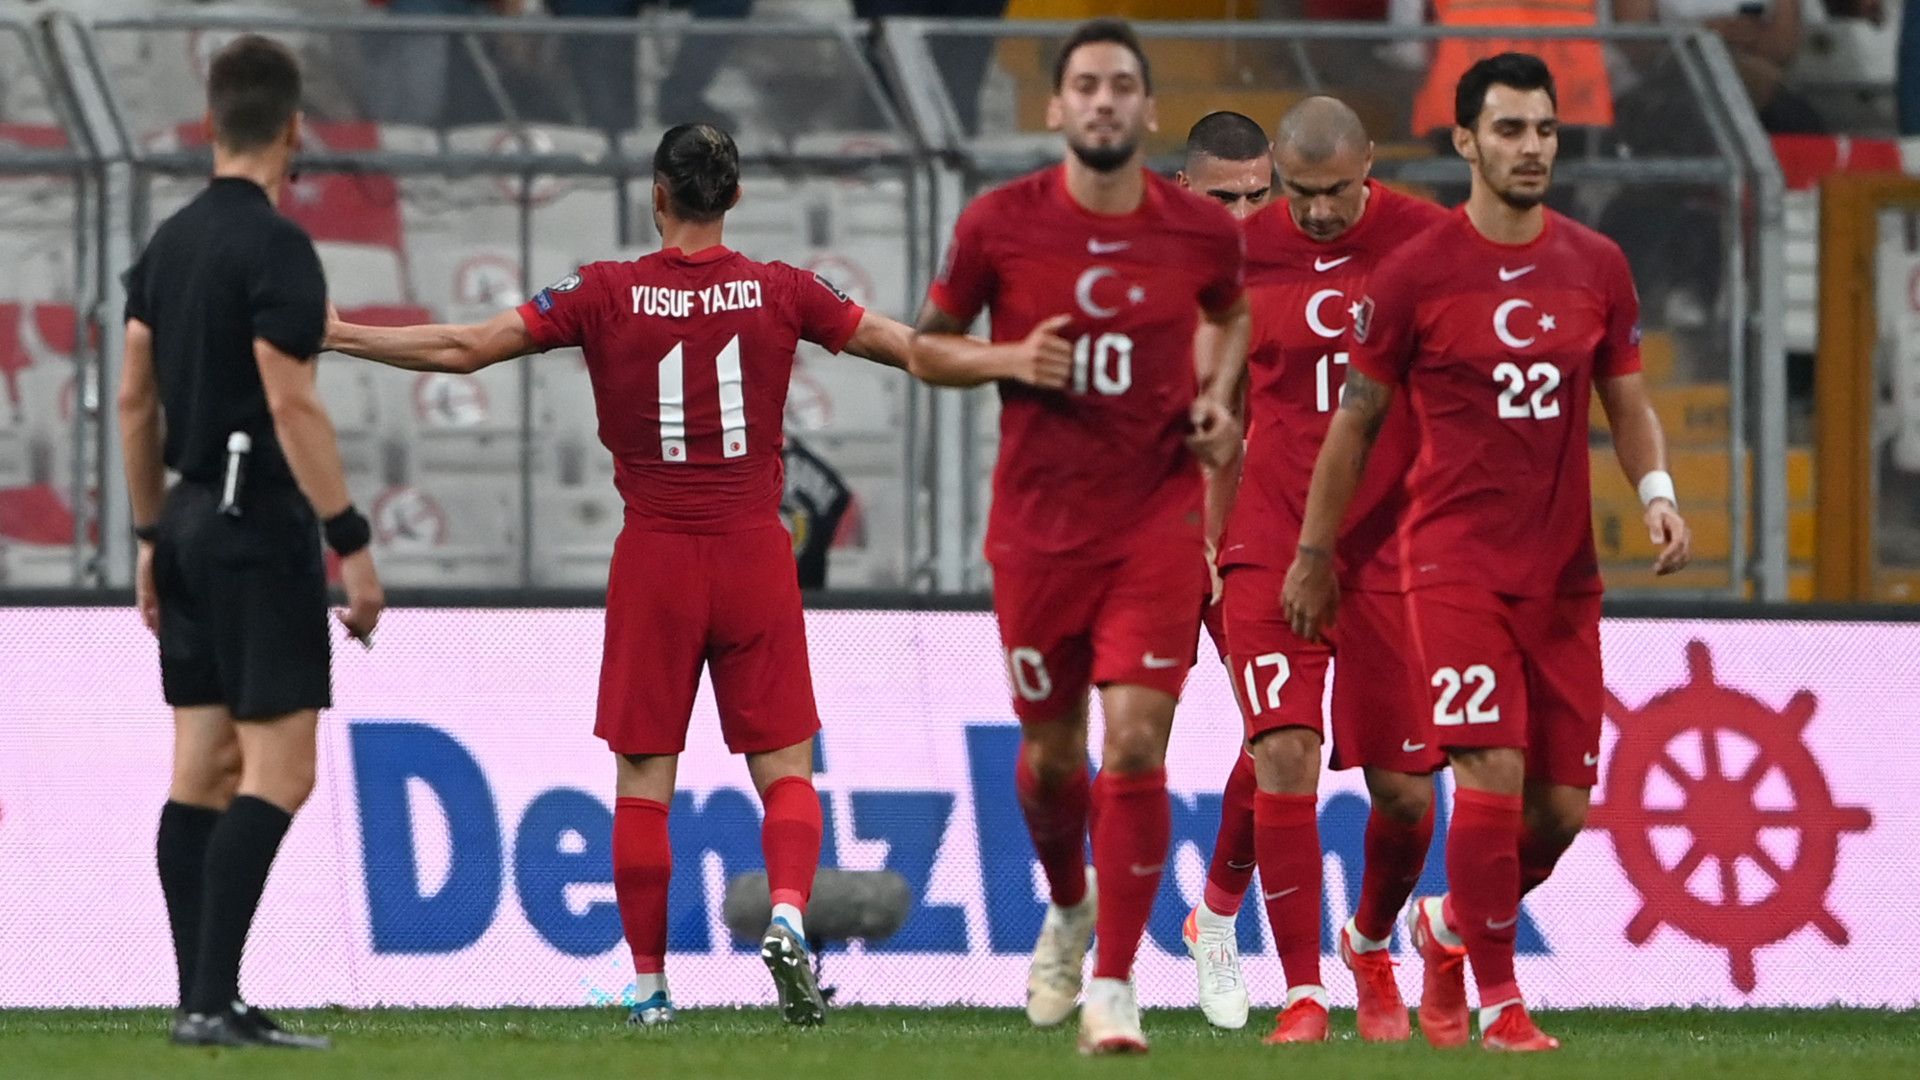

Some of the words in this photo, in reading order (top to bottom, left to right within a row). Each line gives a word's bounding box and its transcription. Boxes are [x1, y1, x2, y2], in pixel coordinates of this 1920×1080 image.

[631, 285, 696, 318] YUSUF
[698, 280, 763, 315] YAZICI
[1073, 333, 1133, 396] 10
[1492, 362, 1561, 420] 22
[658, 333, 747, 462] 11
[1006, 647, 1052, 701] 0
[1243, 652, 1291, 716] 17
[1430, 664, 1500, 726] 22
[348, 721, 1551, 957] DenzBa
